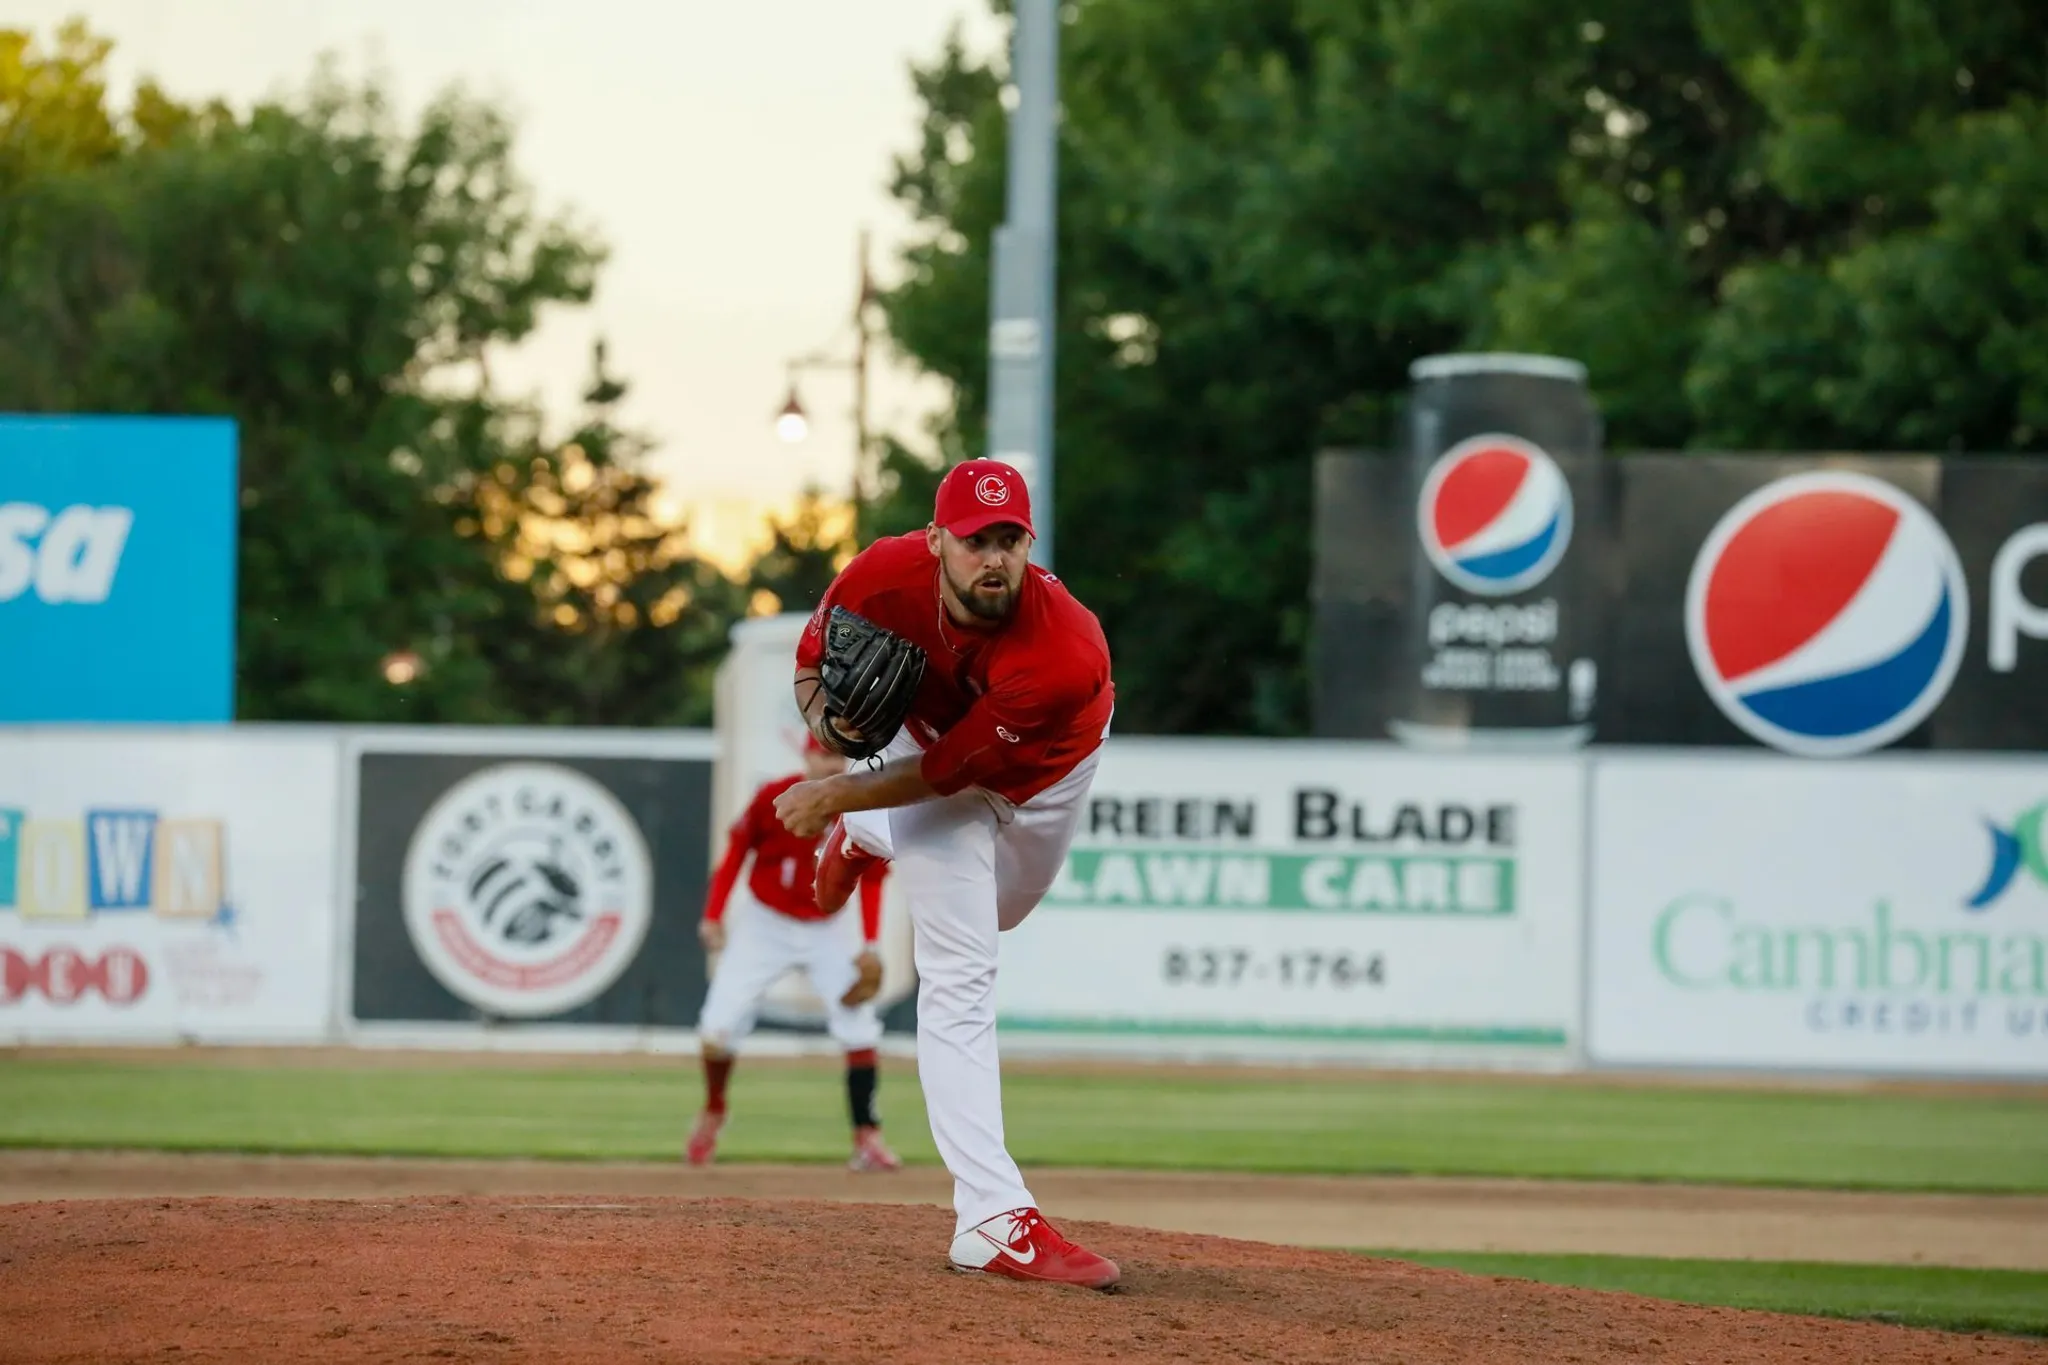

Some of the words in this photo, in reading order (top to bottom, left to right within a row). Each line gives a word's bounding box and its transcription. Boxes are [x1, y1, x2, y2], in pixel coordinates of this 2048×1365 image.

[1429, 599, 1558, 650] pepsi
[430, 794, 504, 882] FORT
[513, 787, 624, 882] GARRY
[1076, 797, 1254, 840] REEN
[1302, 856, 1500, 908] CARE
[1803, 1001, 1980, 1034] CREDIT
